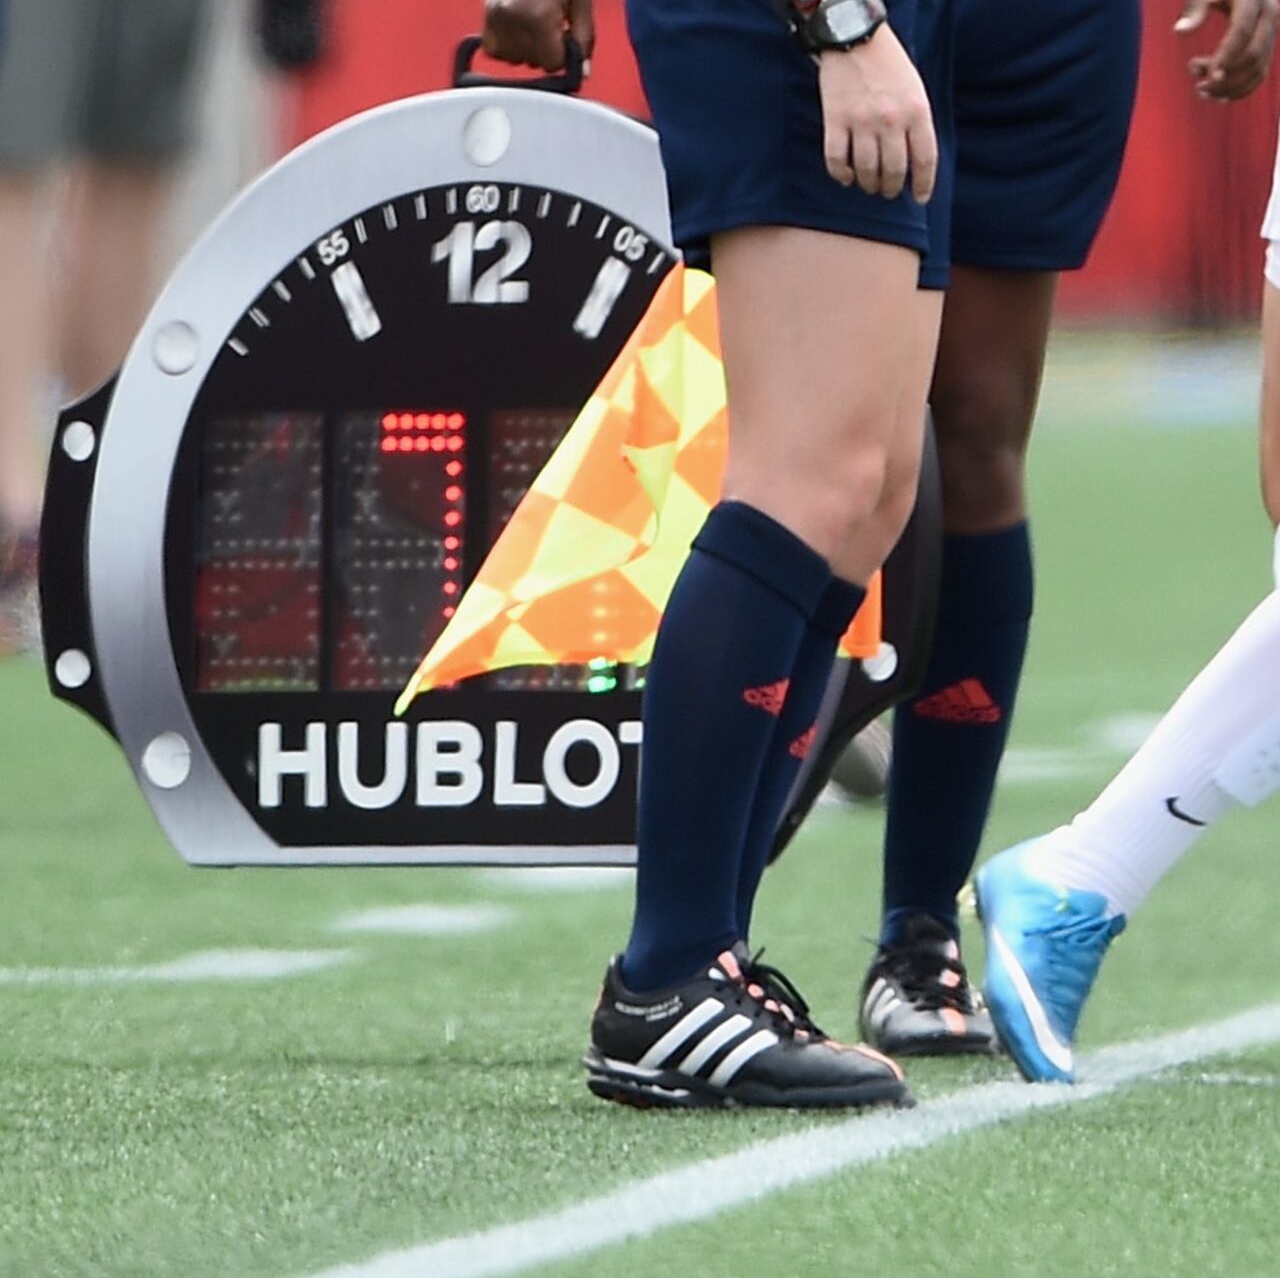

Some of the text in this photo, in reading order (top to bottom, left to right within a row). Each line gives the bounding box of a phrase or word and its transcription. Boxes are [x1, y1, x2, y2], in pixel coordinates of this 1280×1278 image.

[465, 185, 500, 213] 60
[316, 229, 350, 266] 55
[611, 226, 647, 261] 05
[430, 220, 532, 304] 12
